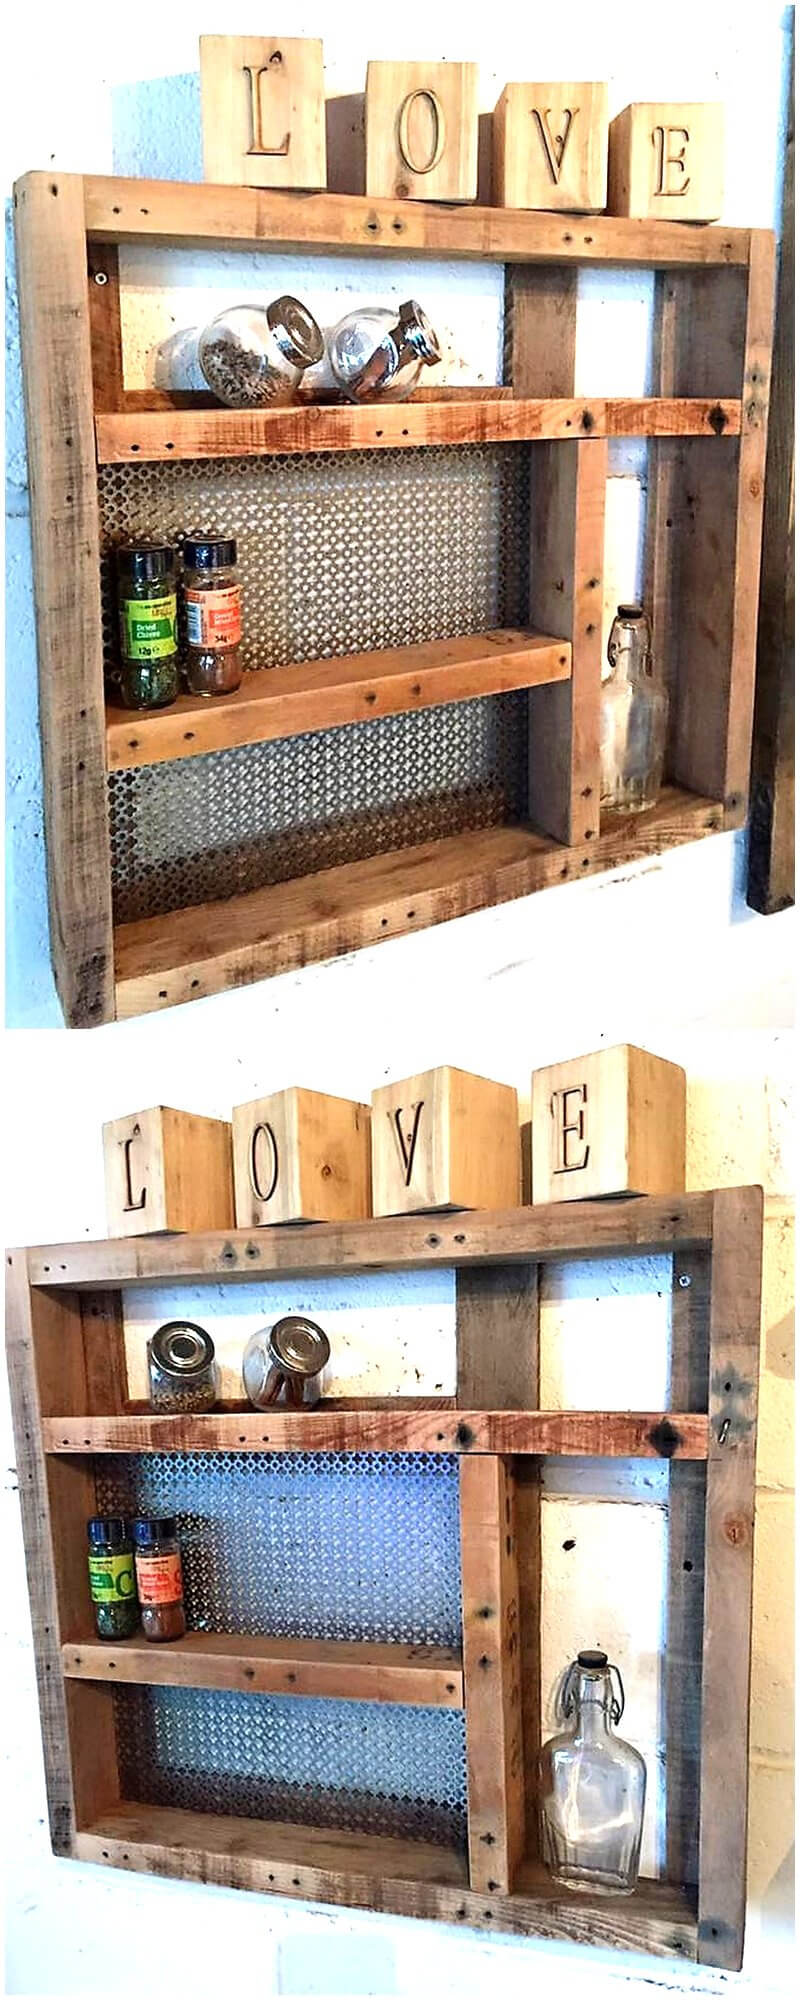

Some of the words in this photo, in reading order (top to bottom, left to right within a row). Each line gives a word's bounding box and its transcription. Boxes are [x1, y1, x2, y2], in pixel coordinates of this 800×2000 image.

[242, 66, 292, 156] L
[399, 87, 446, 174] O
[530, 107, 581, 185] V
[651, 124, 691, 197] E
[118, 1138, 147, 1213] L
[248, 1121, 279, 1202] O
[387, 1100, 425, 1187] V
[549, 1082, 591, 1174] E
